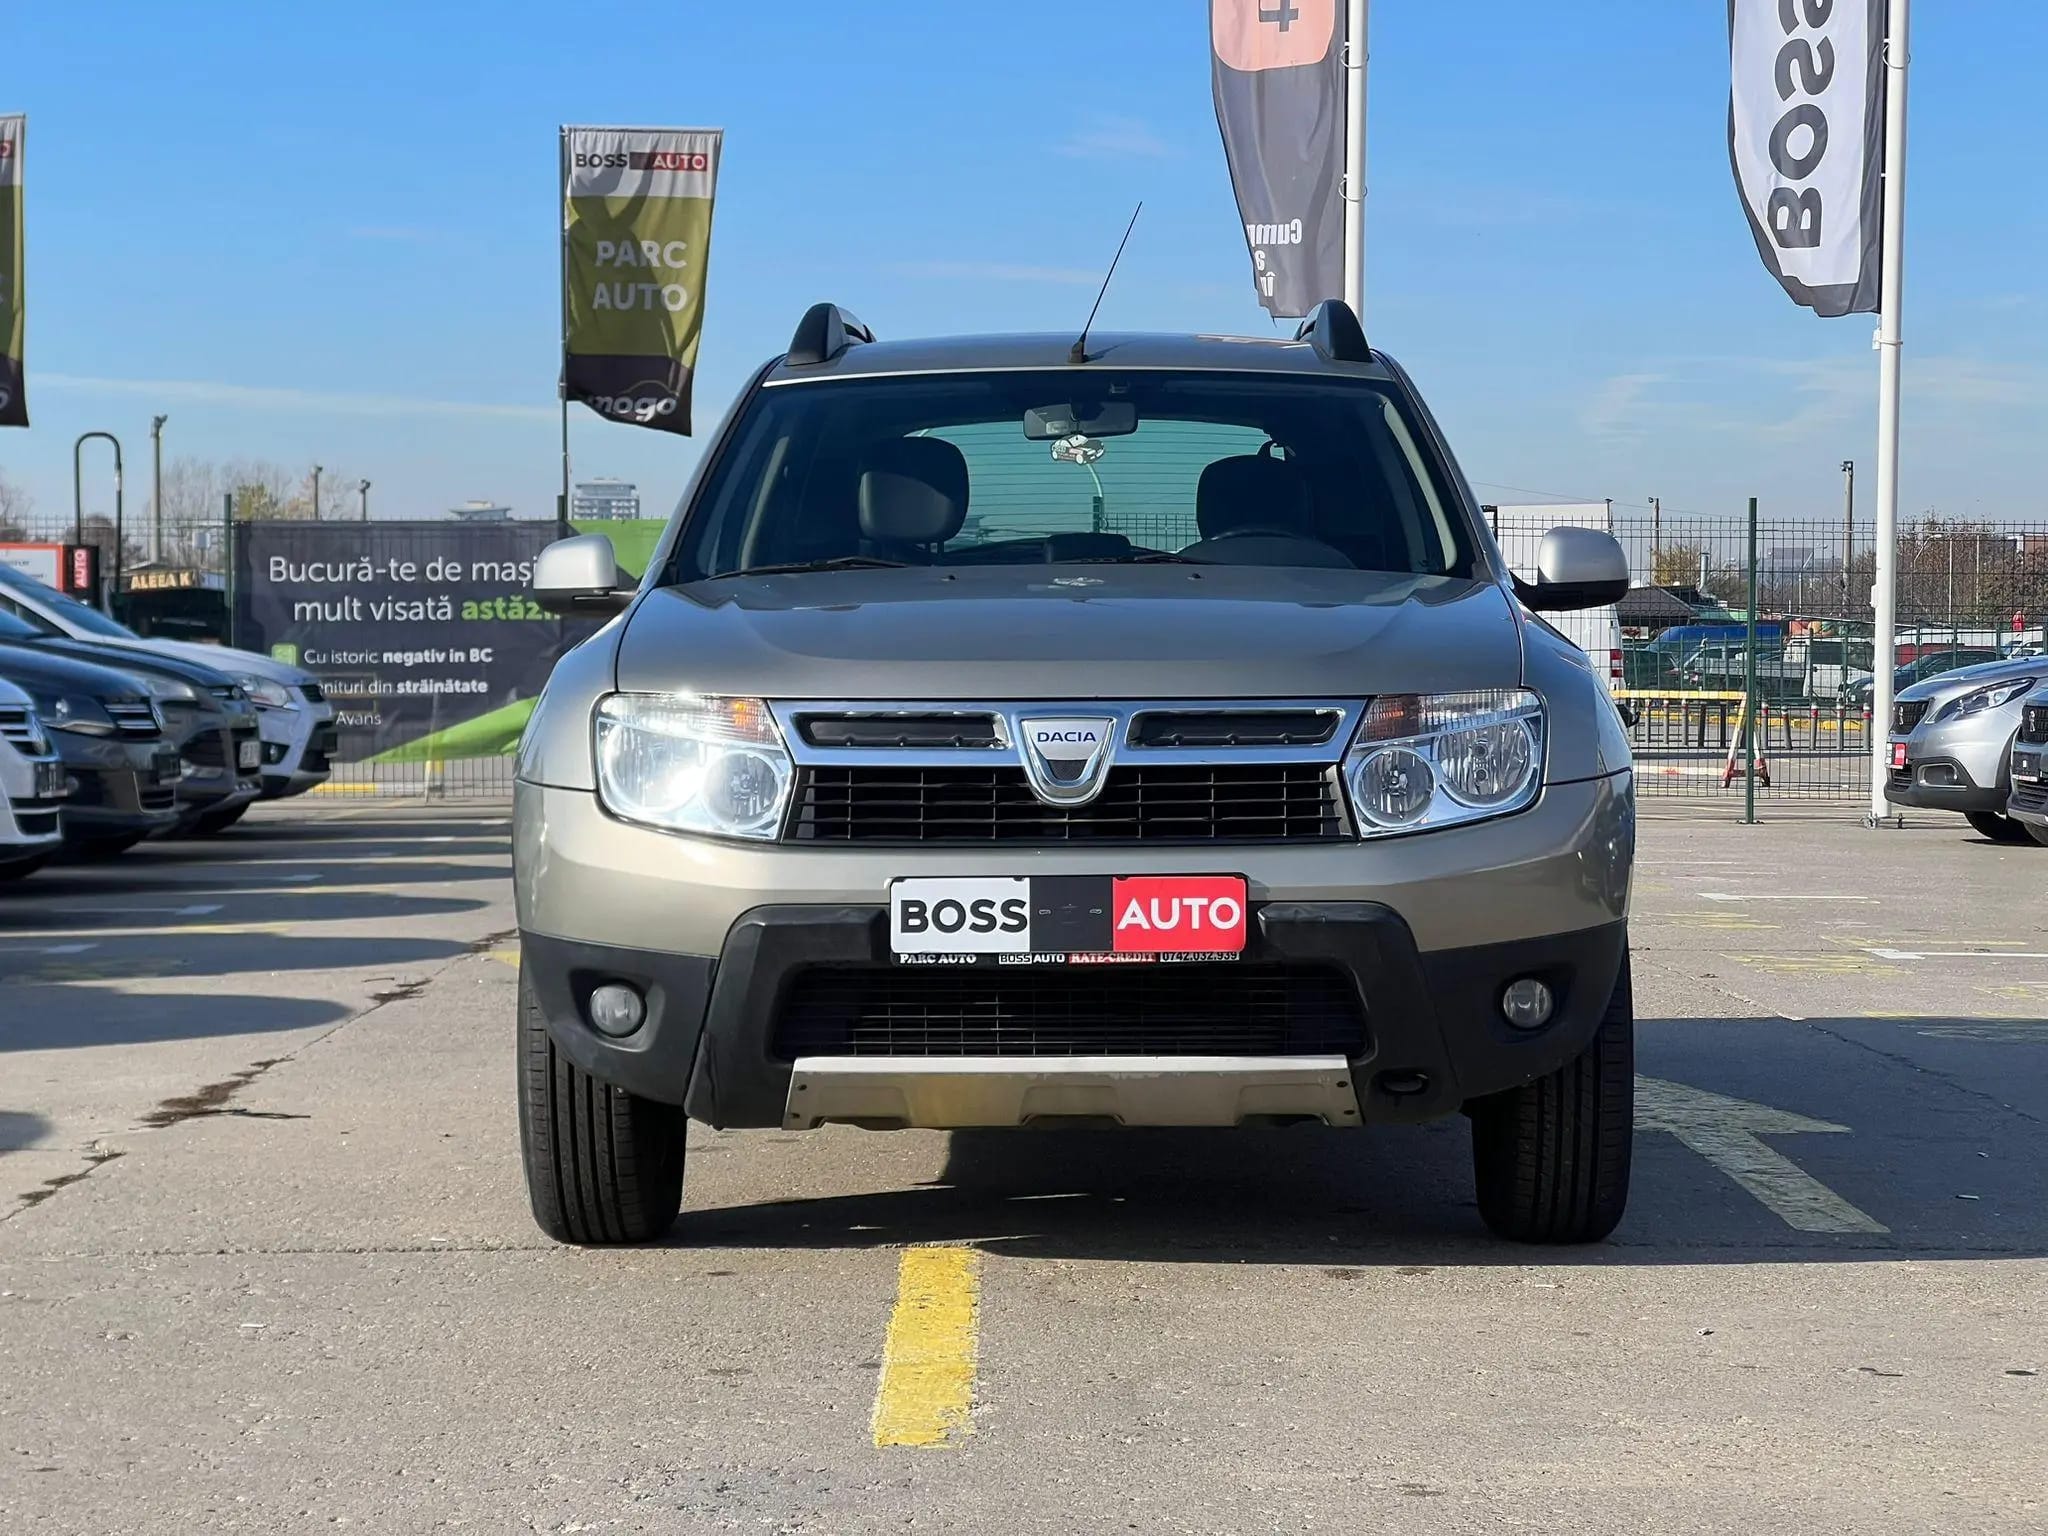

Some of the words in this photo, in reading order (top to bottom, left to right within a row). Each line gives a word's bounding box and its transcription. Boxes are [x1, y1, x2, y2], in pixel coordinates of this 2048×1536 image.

[575, 153, 628, 169] BOSS
[653, 153, 706, 169] AUTO
[594, 240, 688, 269] PARC
[592, 282, 688, 312] AUTO
[74, 550, 88, 588] AUTO
[269, 556, 417, 582] Bucură-te
[425, 556, 463, 582] de
[294, 595, 363, 622] mult
[369, 595, 453, 622] visată
[461, 597, 561, 621] astăz
[304, 650, 327, 664] Cu
[331, 649, 379, 664] istoric
[382, 649, 446, 667] negativ
[469, 649, 494, 663] BC
[368, 679, 393, 694] din
[395, 679, 488, 694] străinătate
[335, 711, 382, 726] Avans
[1037, 732, 1097, 742] DACIA
[900, 898, 1029, 934] BOSS
[1116, 897, 1242, 931] AUTO
[899, 953, 936, 964] PARC
[938, 953, 977, 964] AUTO
[1001, 953, 1031, 964] BOSS
[1033, 953, 1066, 964] AUTO
